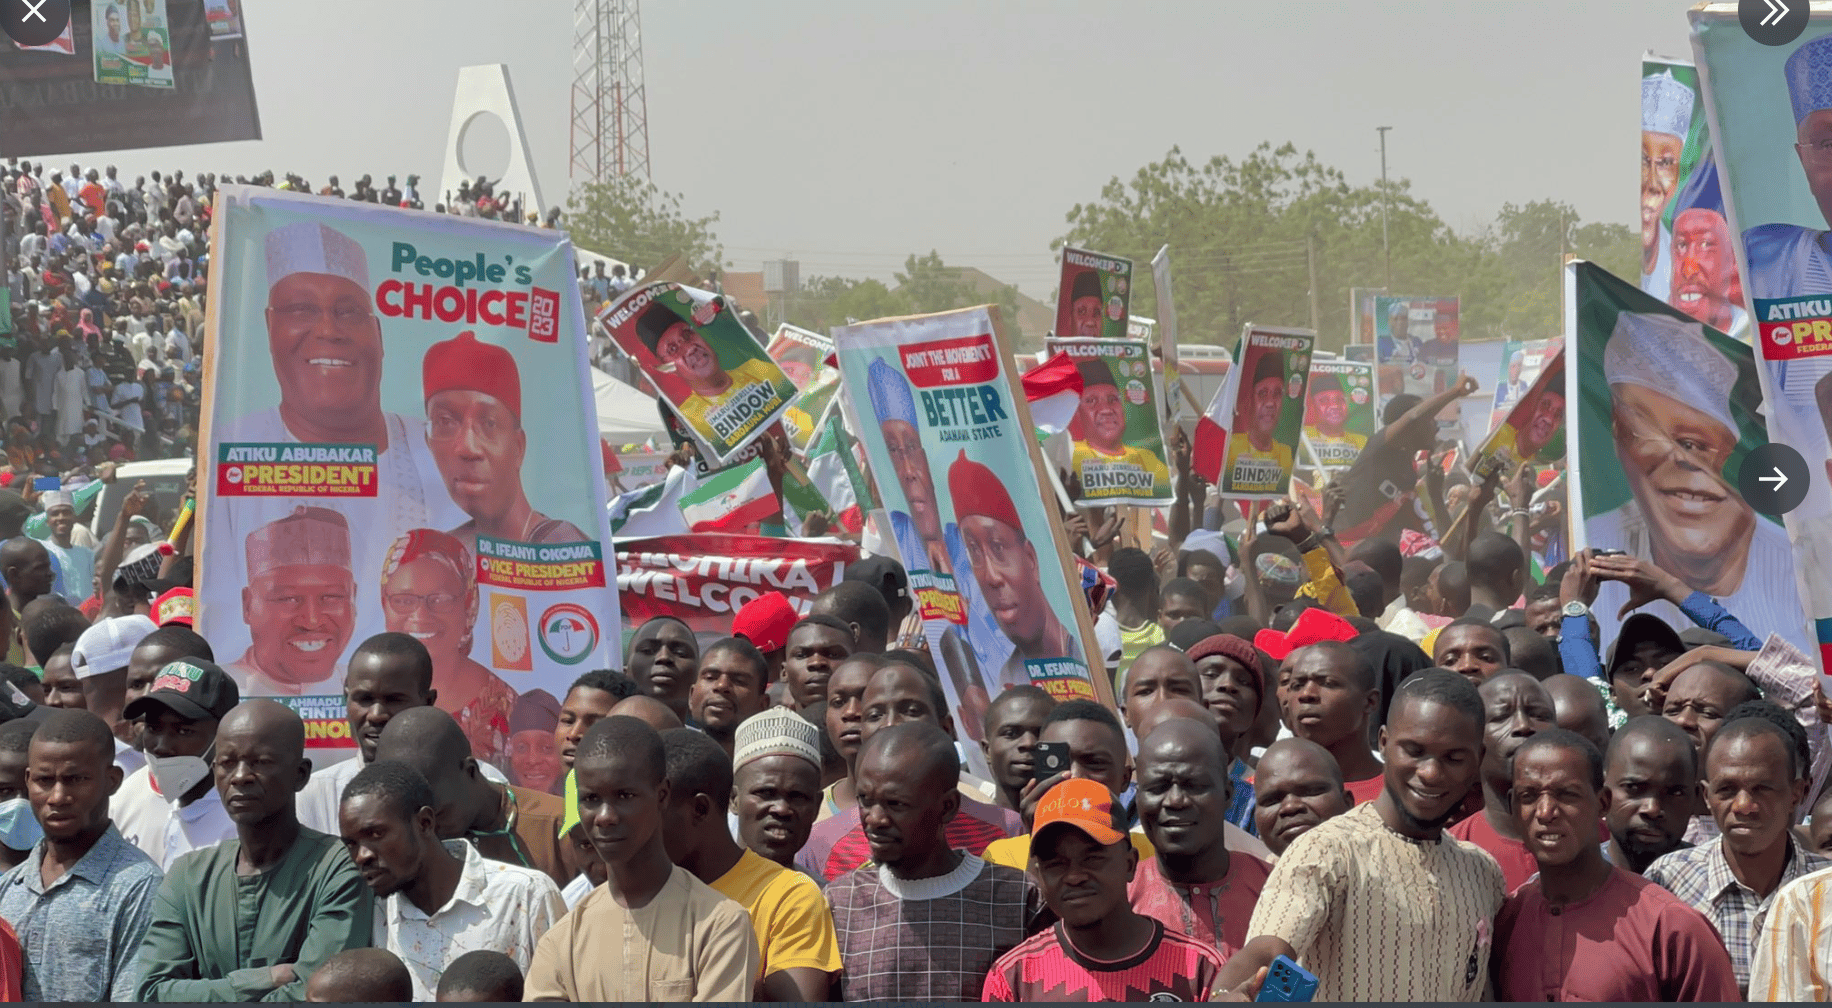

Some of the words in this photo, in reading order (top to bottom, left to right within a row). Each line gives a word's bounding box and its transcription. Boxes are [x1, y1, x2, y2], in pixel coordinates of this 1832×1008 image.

[392, 242, 532, 286] People's
[376, 279, 529, 329] CHOICE
[1768, 299, 1832, 320] ATIKU
[927, 349, 946, 366] THE
[714, 381, 775, 438] BINDOW
[920, 385, 1009, 427] BETTER
[971, 425, 1003, 441] STATE
[226, 447, 277, 462] ATIKU
[280, 447, 374, 462] ABUBAKAR
[243, 465, 374, 485] PRESIDENT
[1083, 471, 1153, 487] BINDOW
[1233, 466, 1283, 482] BINDOW
[243, 485, 277, 493] FEDERAL
[278, 485, 316, 493] REPUBLIC
[479, 539, 494, 555] DR.
[495, 542, 537, 560] IFEANYI
[539, 545, 595, 561] OKOWA
[488, 558, 514, 576] VICE
[515, 561, 596, 579] PRESIDENT
[1027, 664, 1046, 678] DR.
[289, 697, 342, 708] AHMADU
